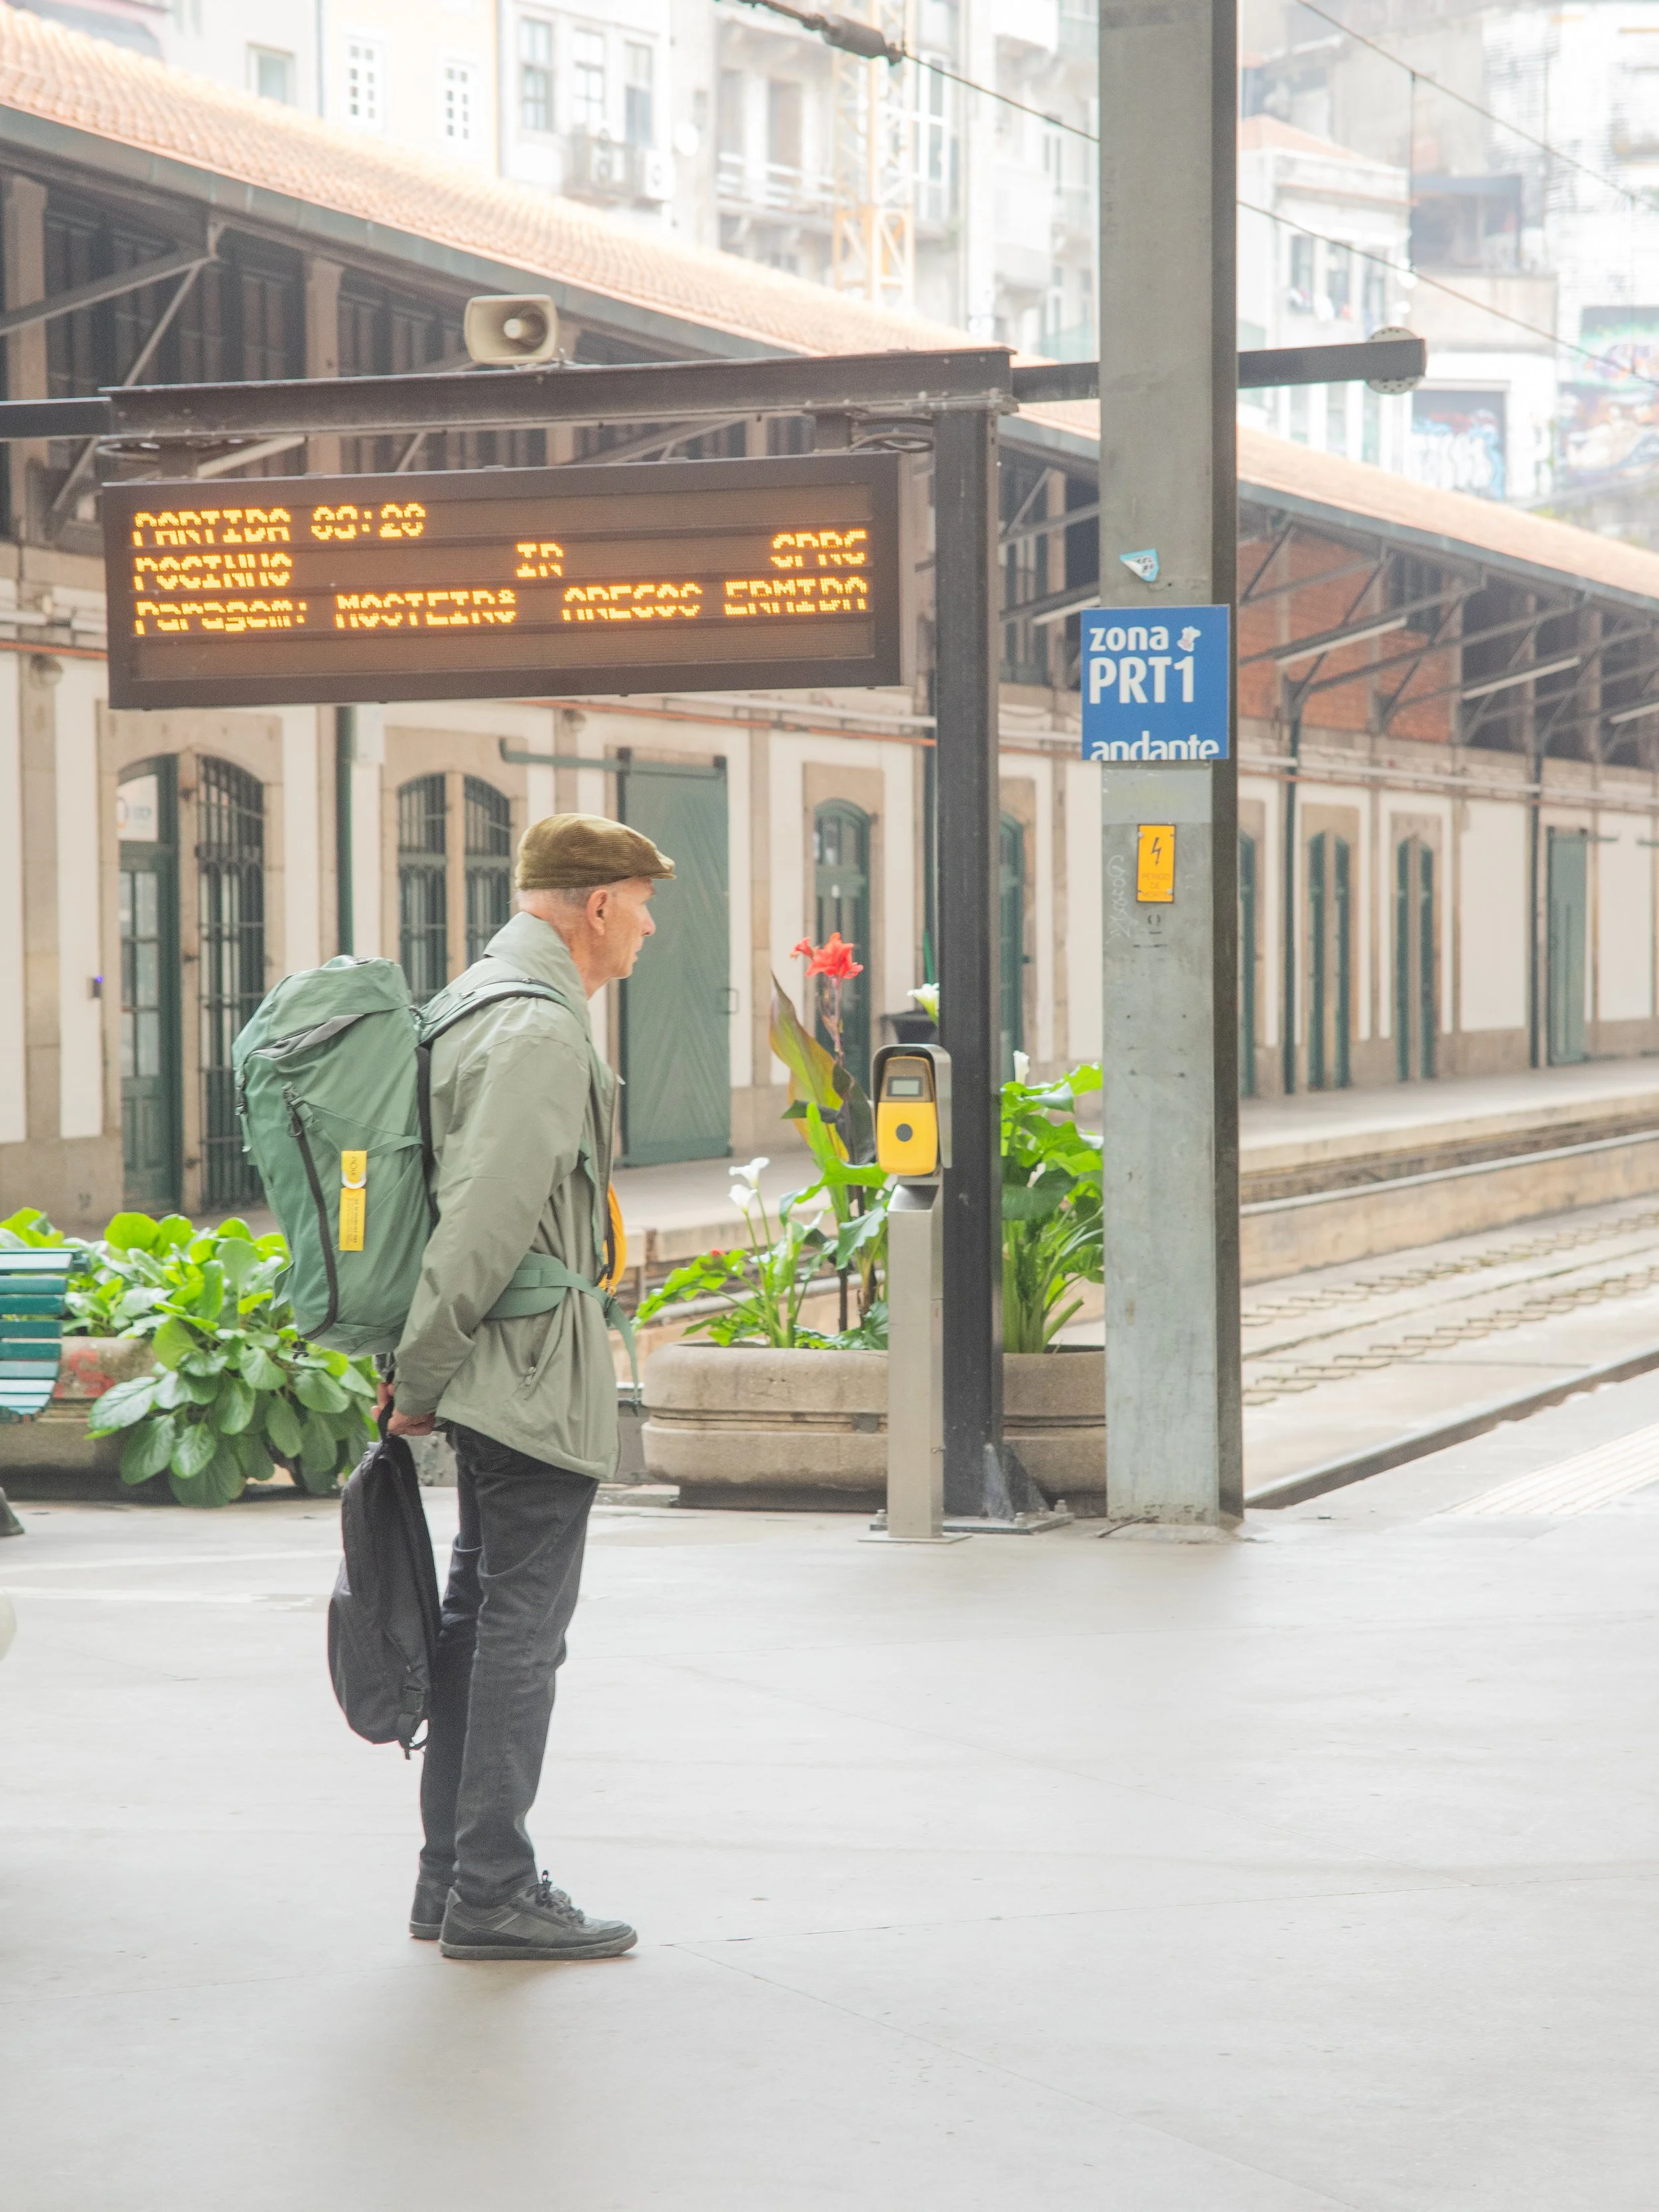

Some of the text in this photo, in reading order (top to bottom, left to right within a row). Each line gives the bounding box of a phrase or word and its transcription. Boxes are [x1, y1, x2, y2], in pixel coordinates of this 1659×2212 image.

[132, 507, 292, 547] PARTIDA
[516, 542, 564, 579] IR
[1089, 626, 1169, 652] zona
[1089, 656, 1194, 705] PRT1
[1090, 730, 1220, 759] andante
